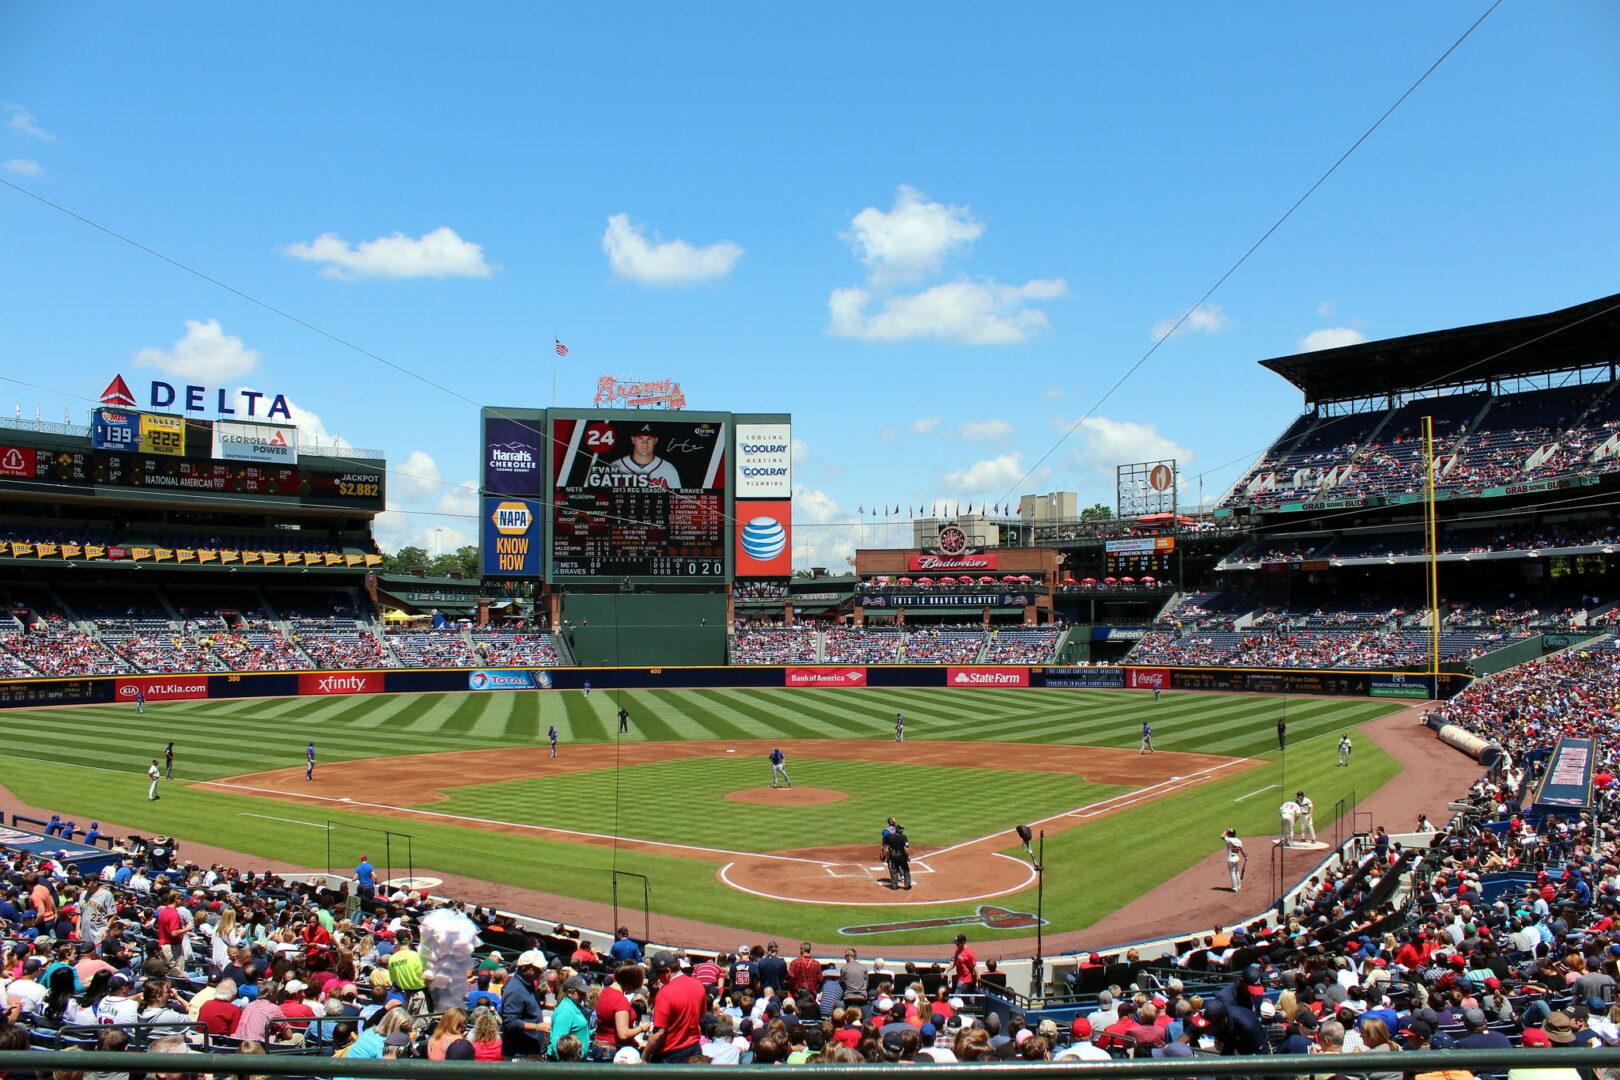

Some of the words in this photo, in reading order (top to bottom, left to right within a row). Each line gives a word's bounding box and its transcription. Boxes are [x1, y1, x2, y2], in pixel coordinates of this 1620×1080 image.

[594, 376, 671, 406] Braves
[151, 381, 291, 419] DELTA
[107, 426, 132, 442] 139
[152, 430, 180, 446] 222
[587, 430, 614, 446] 24
[222, 435, 267, 445] GEORGIA
[253, 446, 288, 455] POWER
[744, 444, 787, 454] COOLRAY
[493, 450, 532, 462] Harrah's
[744, 467, 787, 476] COOLRAY
[146, 476, 178, 486] NATIONAL
[180, 478, 213, 488] AMERICAN
[341, 474, 379, 482] JACKPOT
[590, 474, 648, 488] GATTIS
[340, 483, 378, 496] $2,882
[1506, 486, 1528, 494] GRAB
[1547, 480, 1570, 489] BUDS
[500, 510, 526, 526] NAPA
[496, 538, 528, 554] KNOW
[500, 554, 524, 571] HOW
[918, 558, 988, 569] Budweiser
[689, 563, 696, 574] 0
[702, 563, 709, 574] 2
[714, 563, 721, 574] 0
[1107, 628, 1144, 639] Aaron's
[491, 676, 527, 684] TOTAL
[970, 673, 994, 683] State
[995, 673, 1020, 683] Farm
[148, 685, 205, 694] ATLKia.com
[318, 676, 366, 692] xfinity
[90, 914, 102, 922] 22
[736, 972, 750, 985] 25
